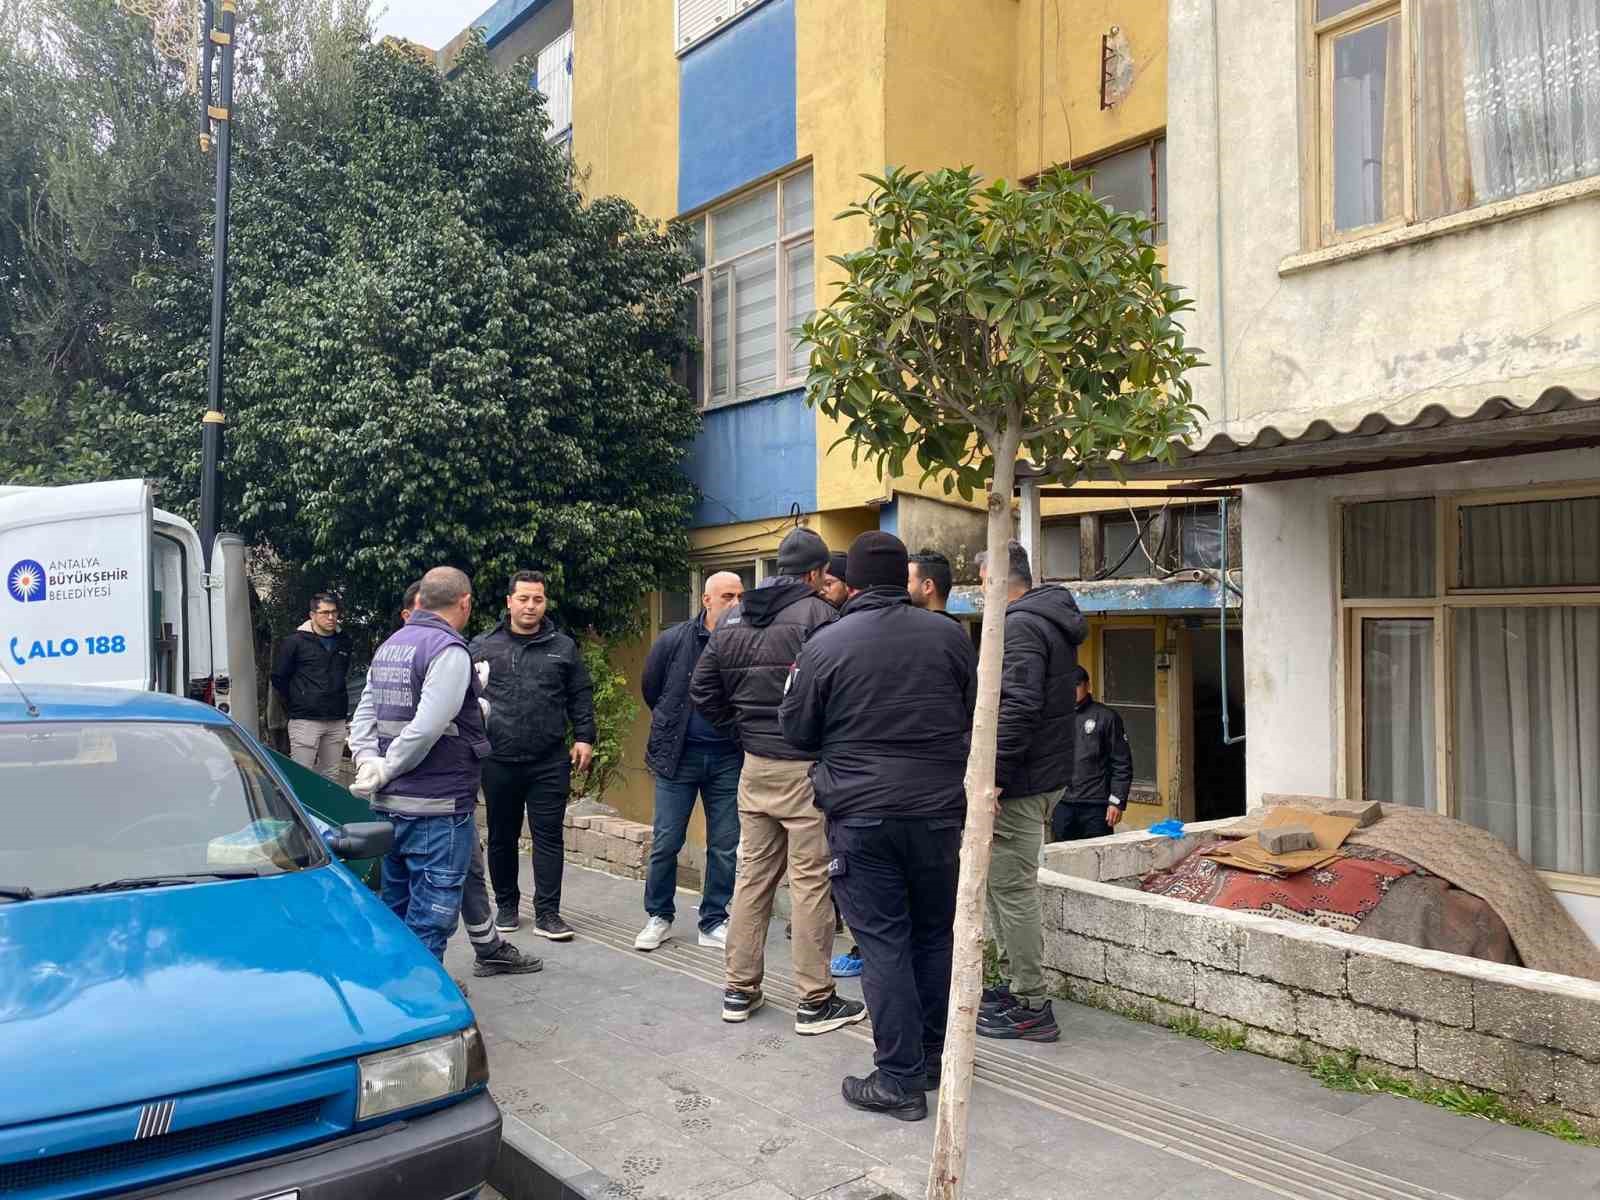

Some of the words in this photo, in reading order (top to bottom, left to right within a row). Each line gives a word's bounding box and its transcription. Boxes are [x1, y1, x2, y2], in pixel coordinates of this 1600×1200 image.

[49, 558, 100, 570] ANTALYA
[49, 568, 128, 586] BÜYÜKŞEHİR
[49, 584, 111, 601] BELEDİYESİ
[28, 638, 79, 659] ALO
[85, 635, 126, 655] 188
